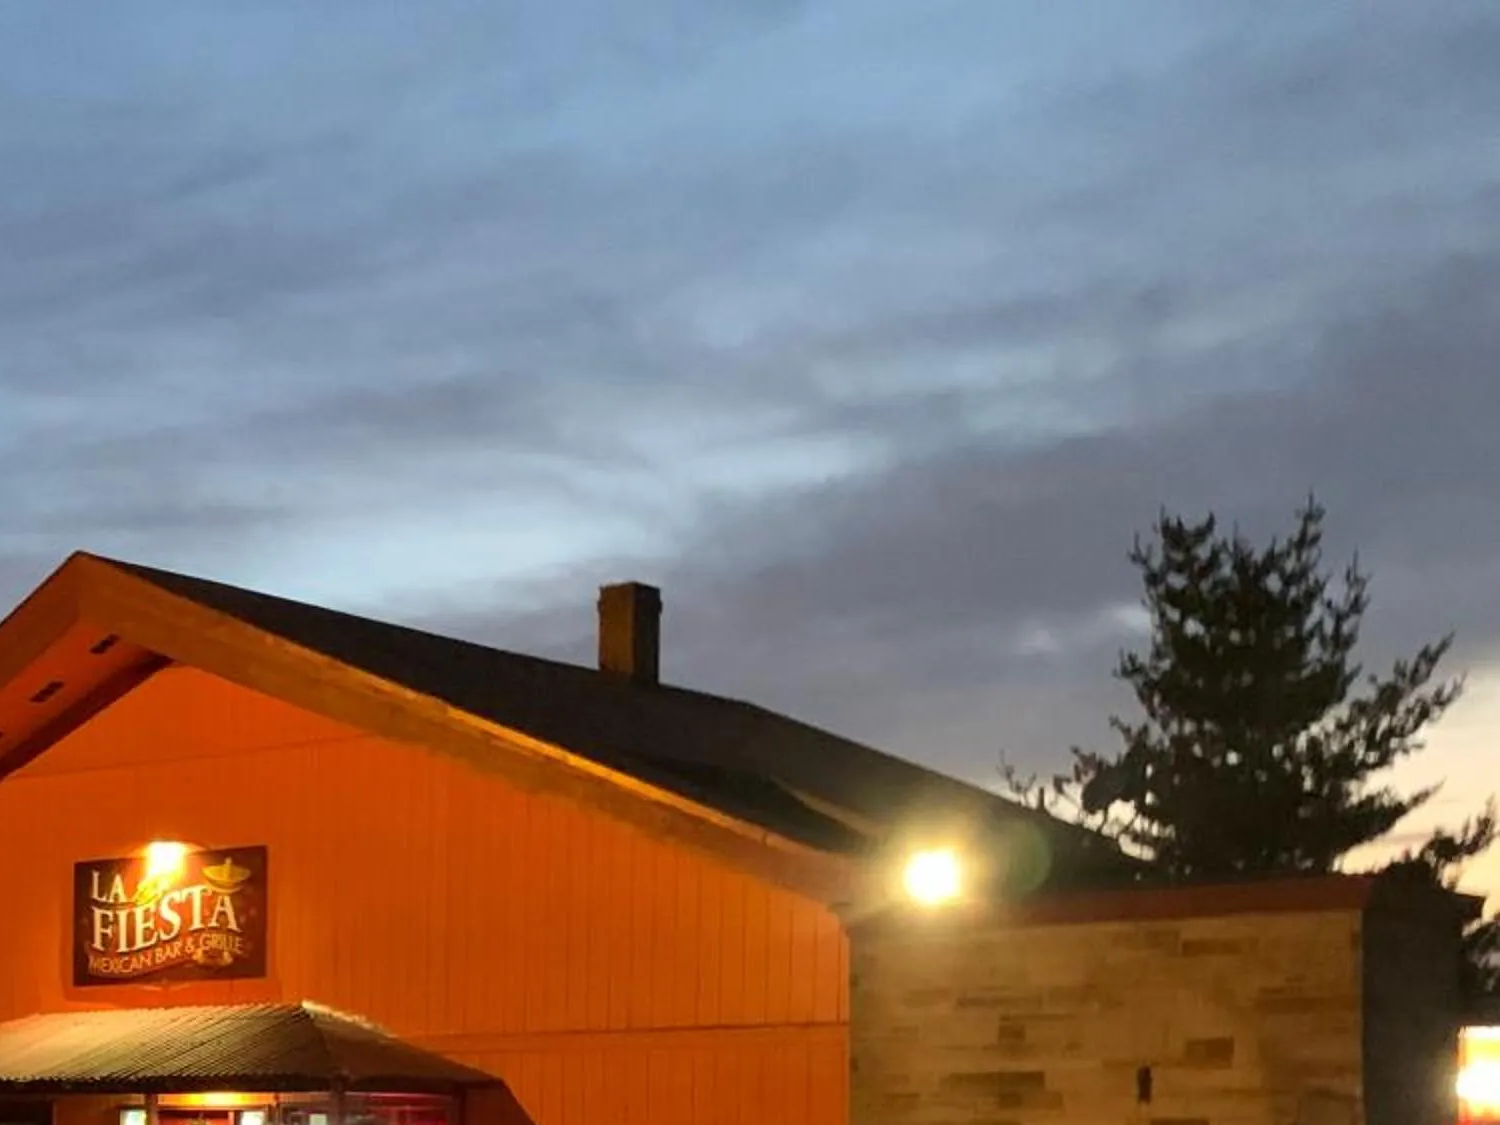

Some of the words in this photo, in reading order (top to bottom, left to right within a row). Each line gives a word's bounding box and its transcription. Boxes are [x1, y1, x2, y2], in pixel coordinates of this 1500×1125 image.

[92, 871, 128, 904] LA
[91, 885, 243, 953] FIESTA
[88, 953, 151, 974] MEXICAN
[156, 941, 182, 963] BAR
[185, 940, 195, 953] &
